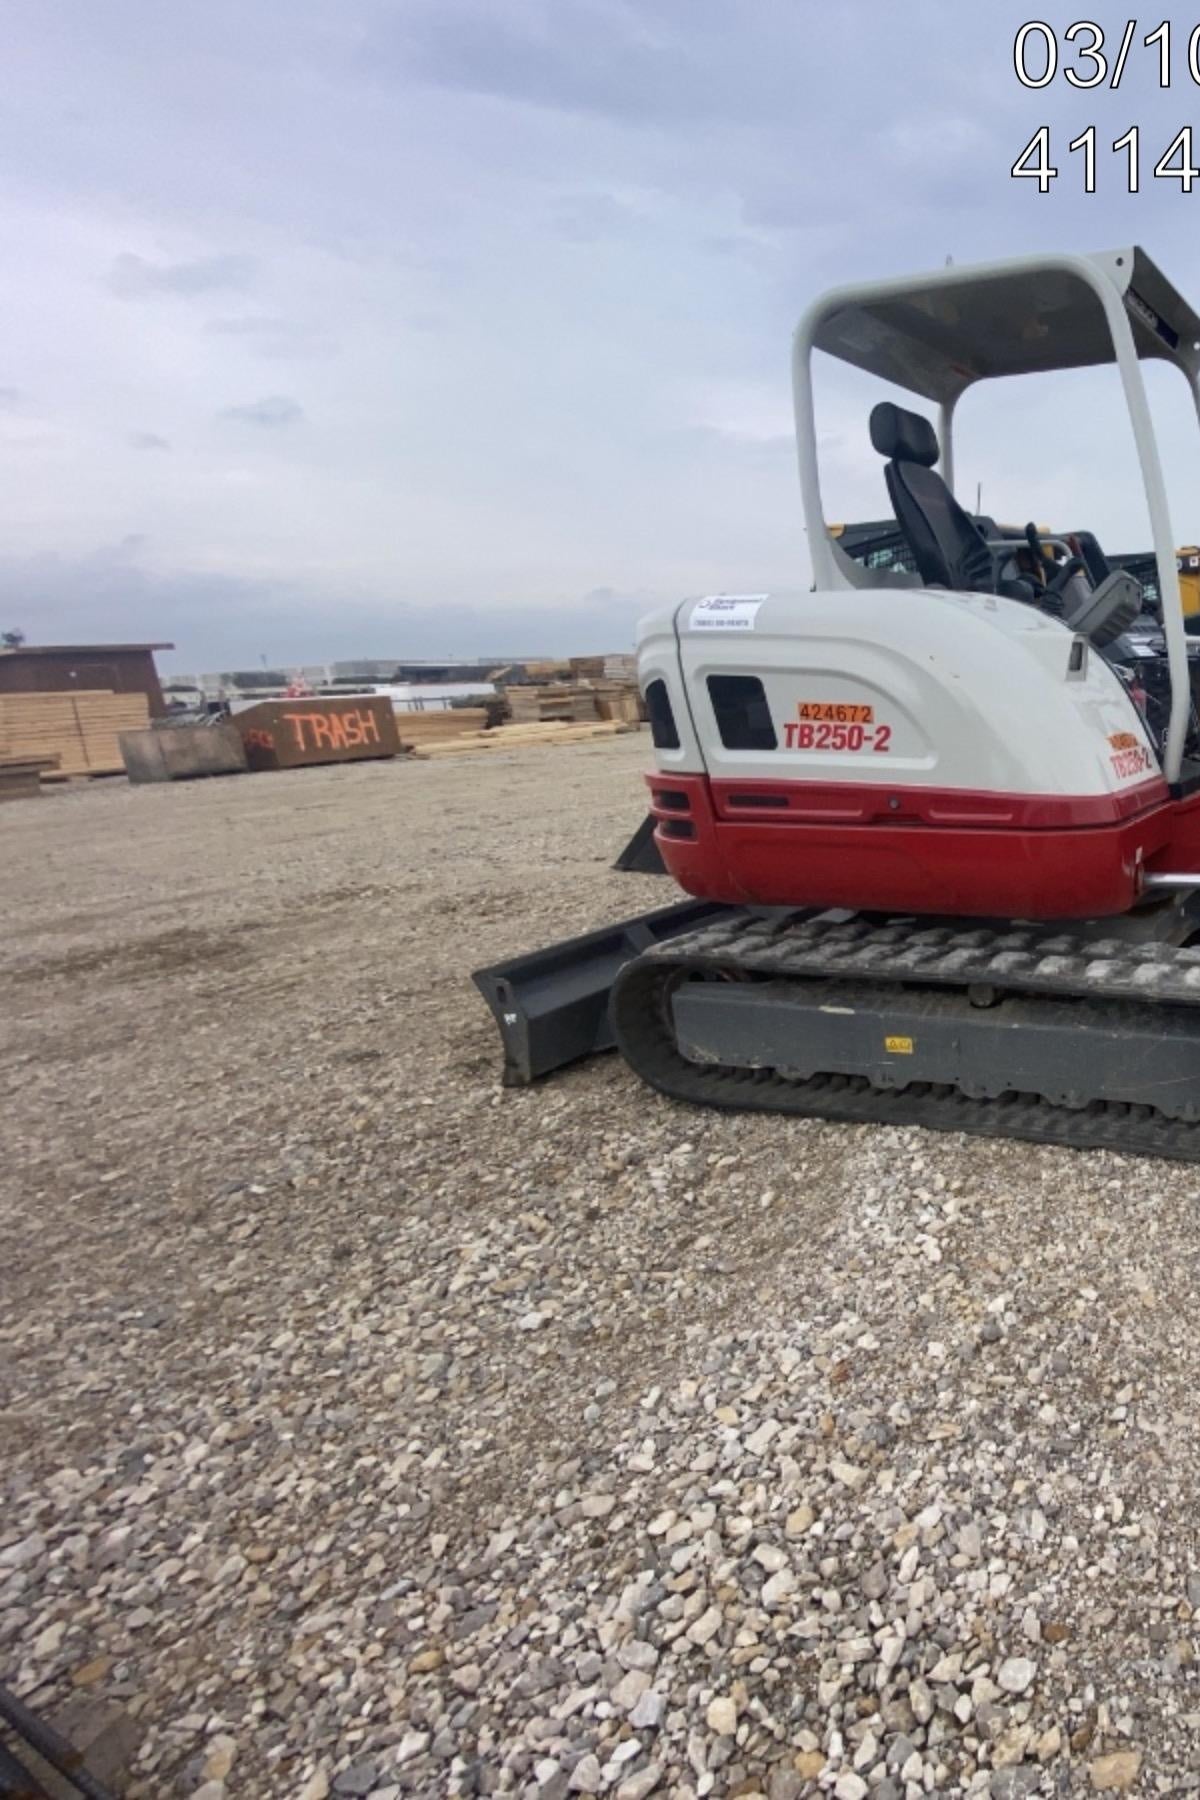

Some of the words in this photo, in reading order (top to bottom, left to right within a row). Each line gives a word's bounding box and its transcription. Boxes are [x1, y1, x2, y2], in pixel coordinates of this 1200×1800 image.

[799, 703, 873, 724] 424672
[282, 708, 381, 752] TRASH
[783, 723, 892, 753] TB250-2
